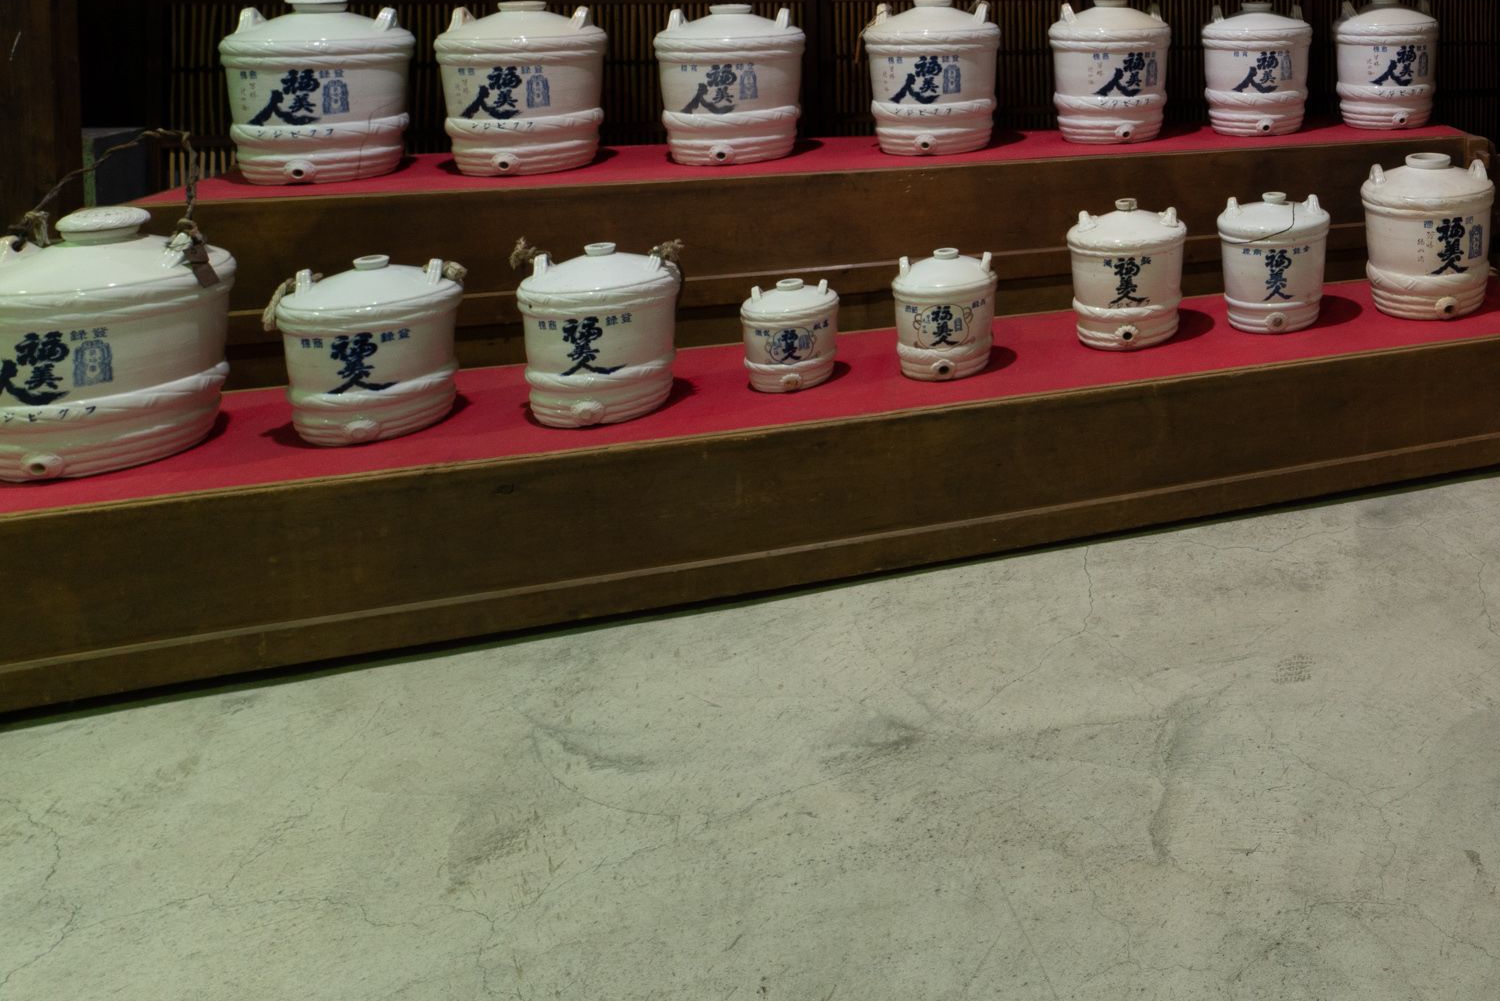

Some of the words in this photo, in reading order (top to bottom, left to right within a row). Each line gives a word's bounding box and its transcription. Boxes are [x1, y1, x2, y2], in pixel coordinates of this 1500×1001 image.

[889, 55, 943, 105] 福美人
[1092, 52, 1146, 98] 福美人
[1231, 50, 1279, 94] 福美人
[1369, 44, 1417, 87] 福美人
[248, 68, 321, 127] 福美人
[460, 66, 524, 120] 福美人
[1430, 217, 1469, 276] 福美人
[1264, 248, 1294, 302] 福美人
